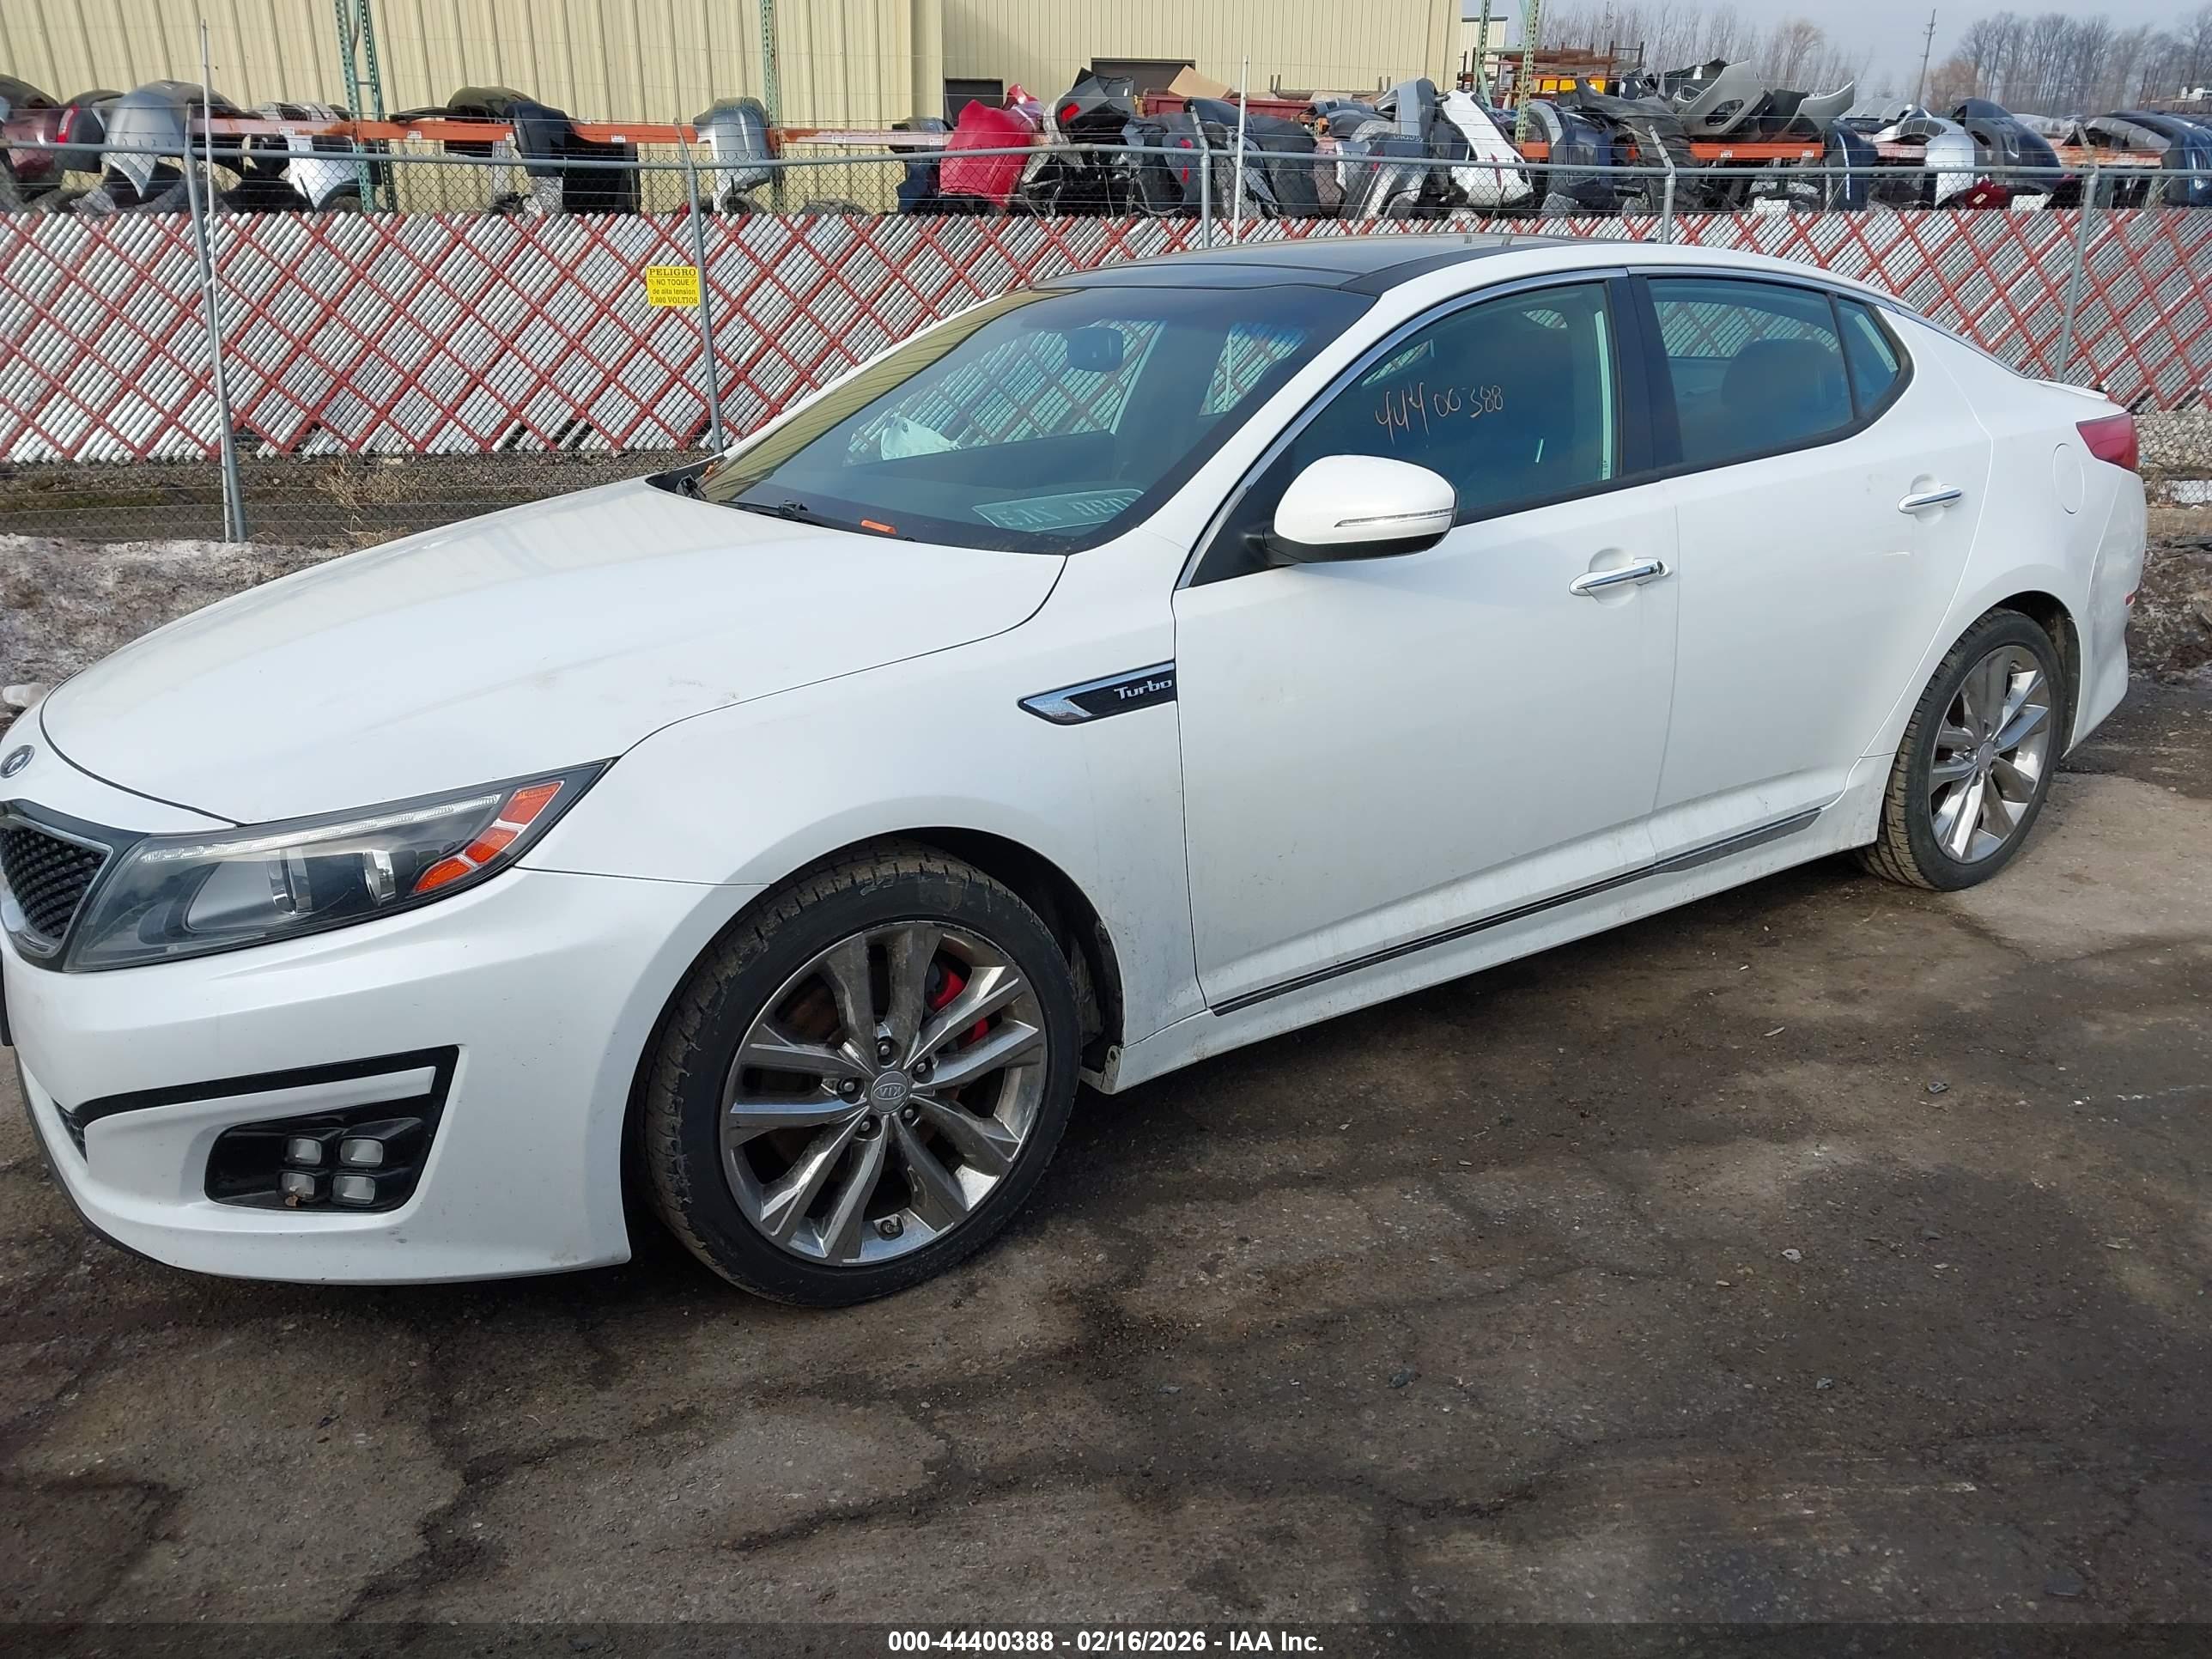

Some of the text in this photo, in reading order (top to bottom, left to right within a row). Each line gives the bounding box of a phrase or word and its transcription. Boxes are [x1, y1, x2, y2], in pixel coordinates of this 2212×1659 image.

[649, 268, 696, 276] PELIGRO
[1114, 679, 1173, 700] Turbo
[879, 1086, 902, 1097] KIA
